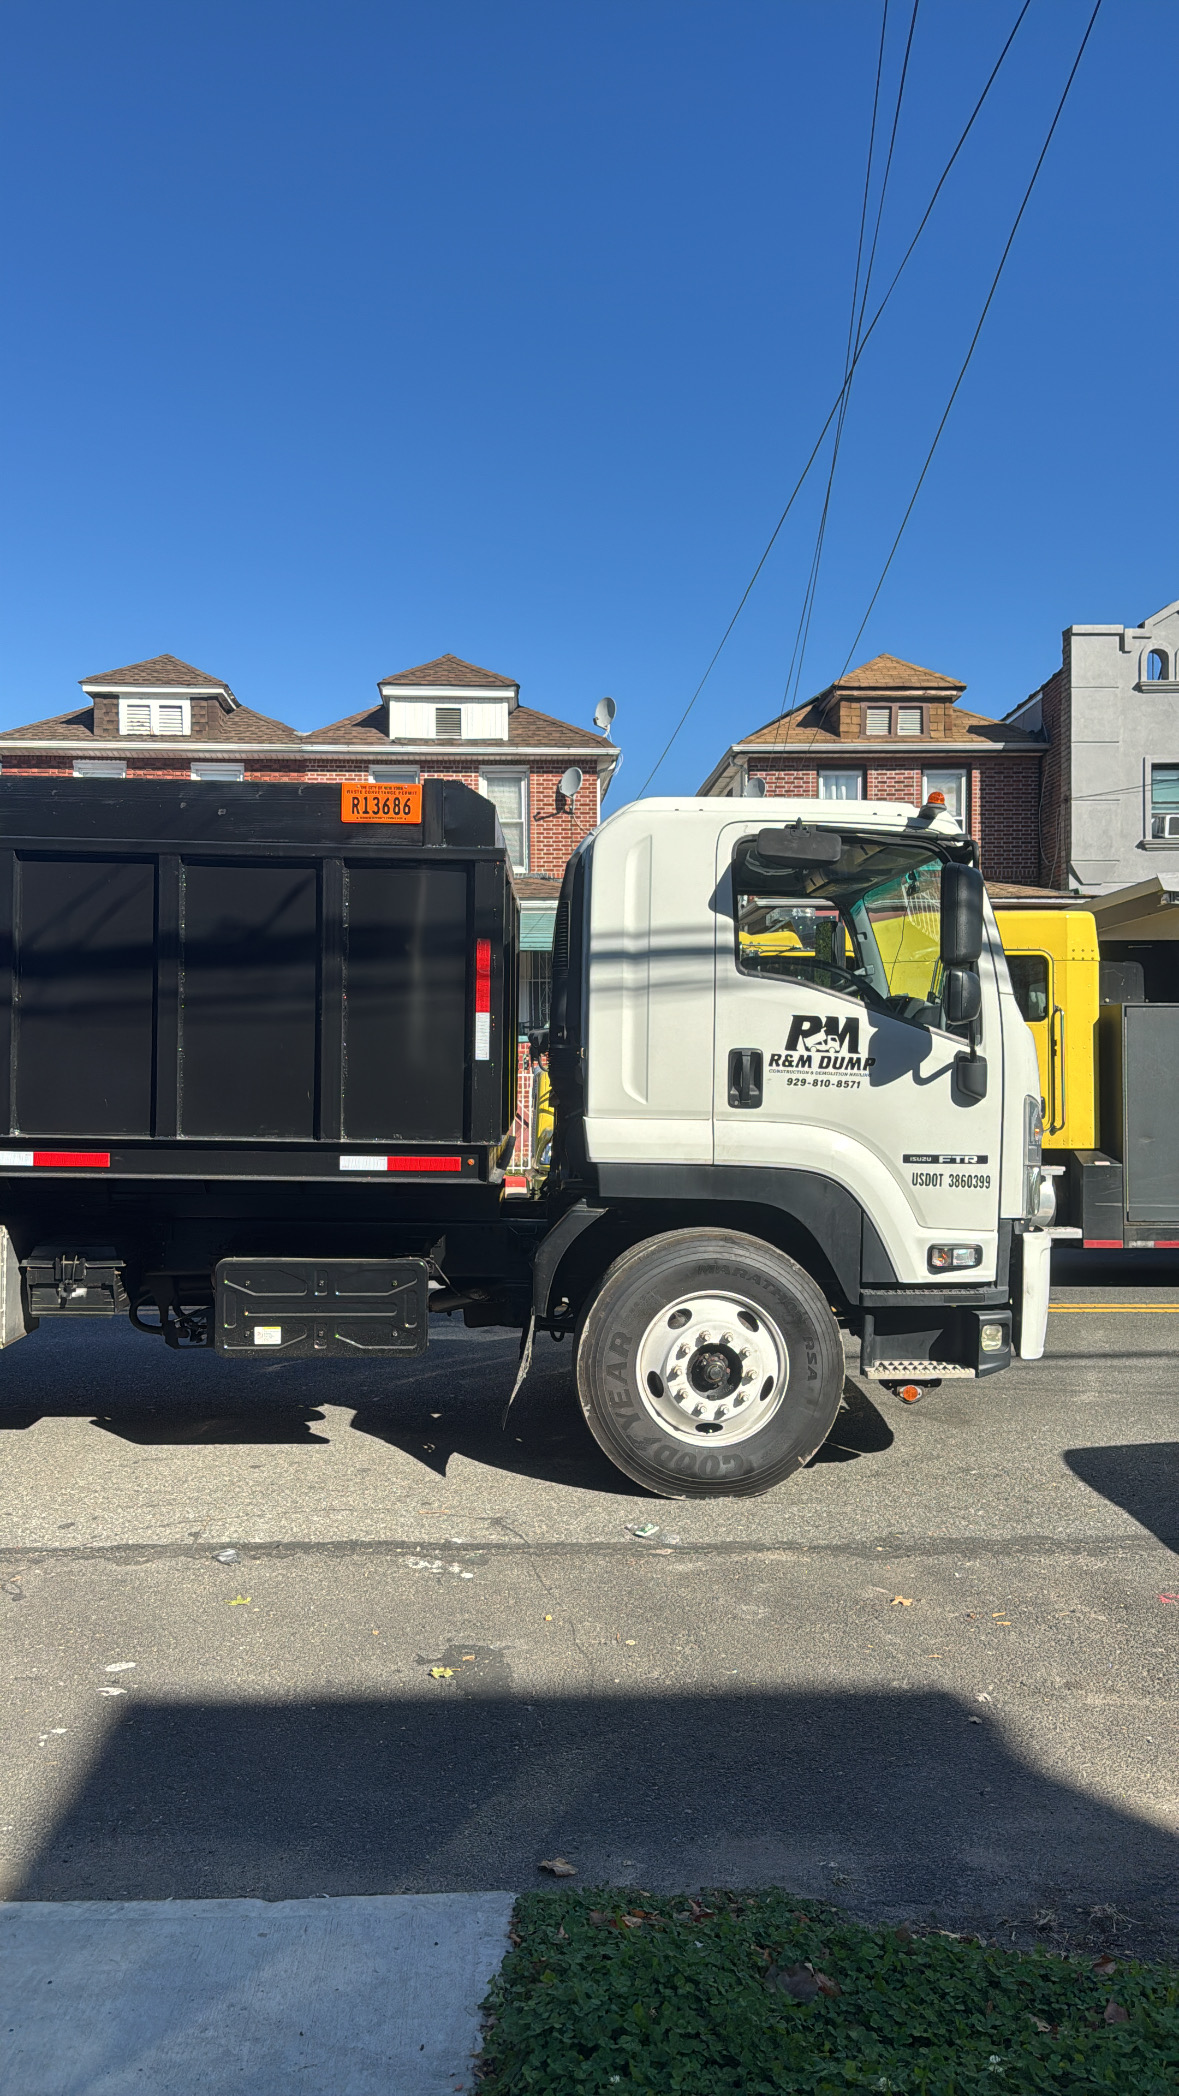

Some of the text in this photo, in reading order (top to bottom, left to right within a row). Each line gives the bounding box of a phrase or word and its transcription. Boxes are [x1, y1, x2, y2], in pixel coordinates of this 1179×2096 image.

[351, 796, 411, 815] R13686
[768, 1053, 876, 1071] R&M DUMP
[786, 1077, 861, 1089] 929-810-8571
[938, 1155, 978, 1164] FTR
[911, 1172, 991, 1189] USDOT 3860399
